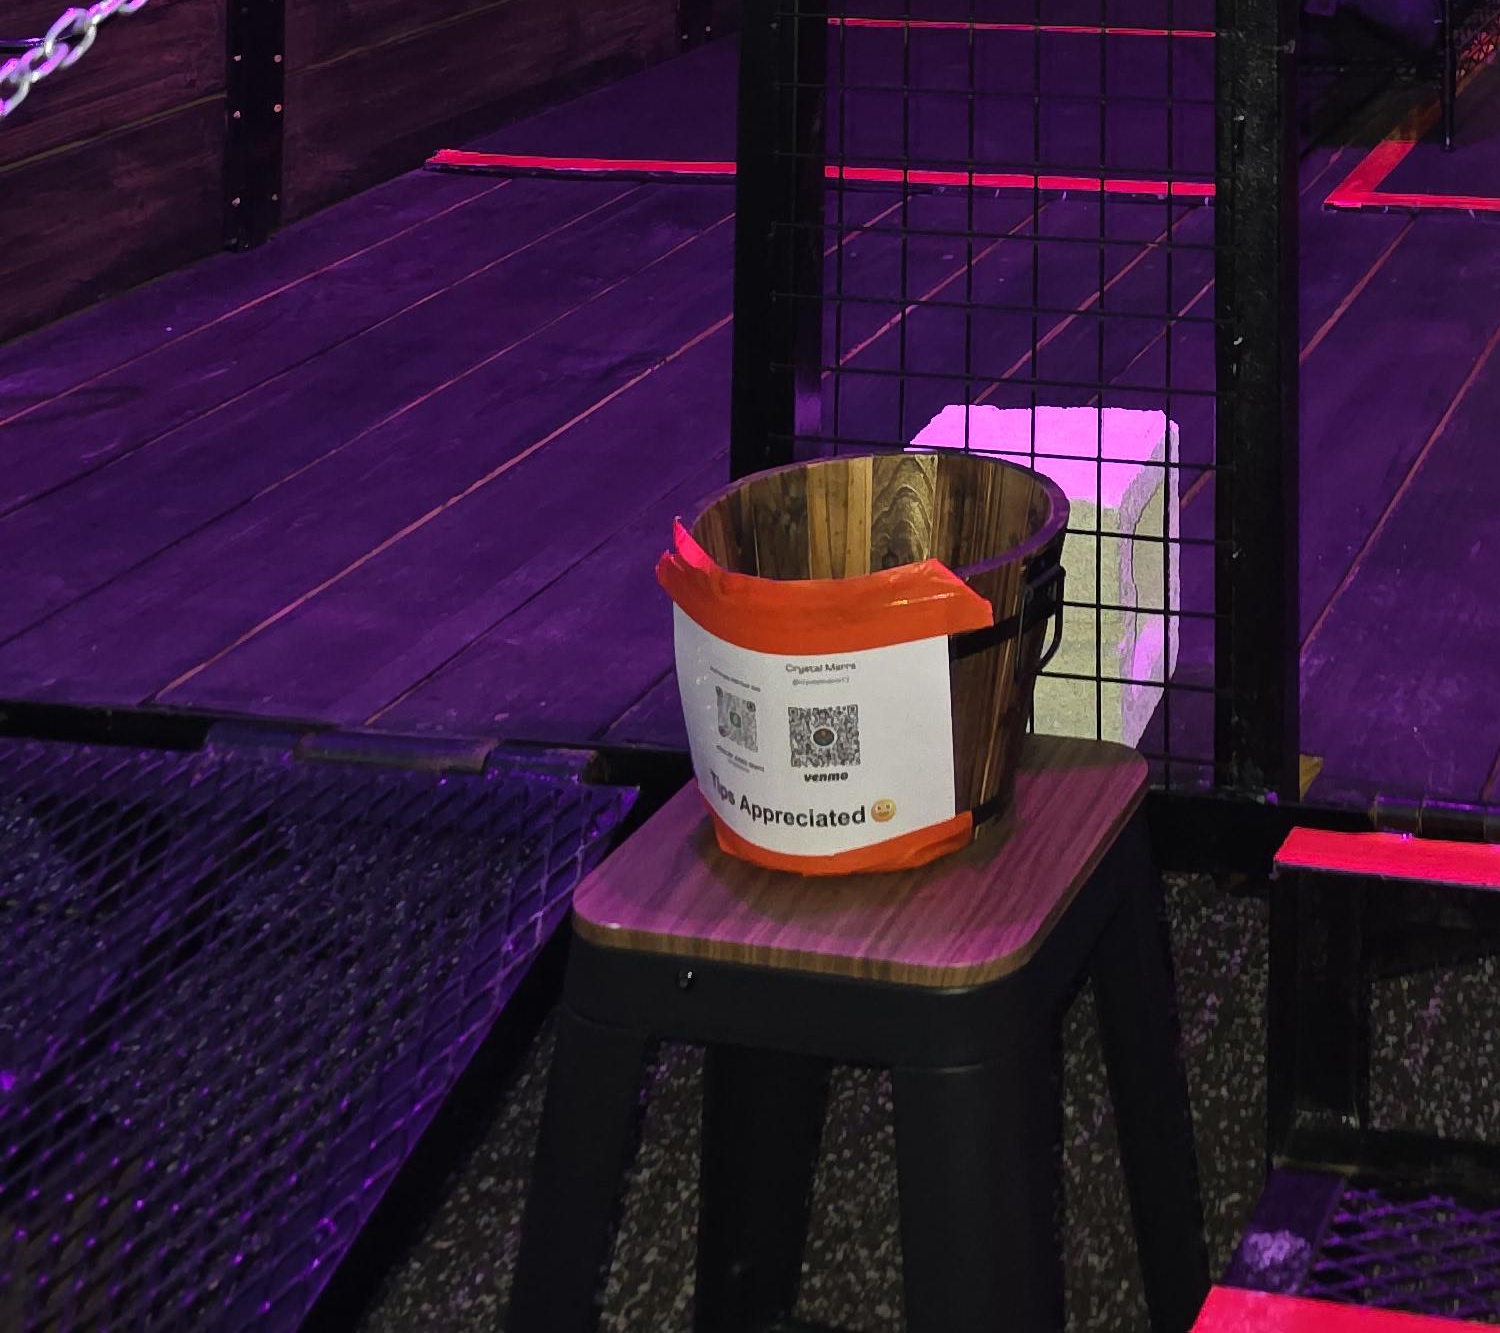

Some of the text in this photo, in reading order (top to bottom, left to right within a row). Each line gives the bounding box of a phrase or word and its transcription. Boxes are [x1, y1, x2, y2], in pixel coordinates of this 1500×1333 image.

[804, 770, 849, 782] venmo
[710, 770, 867, 828] Tips Appreciated
